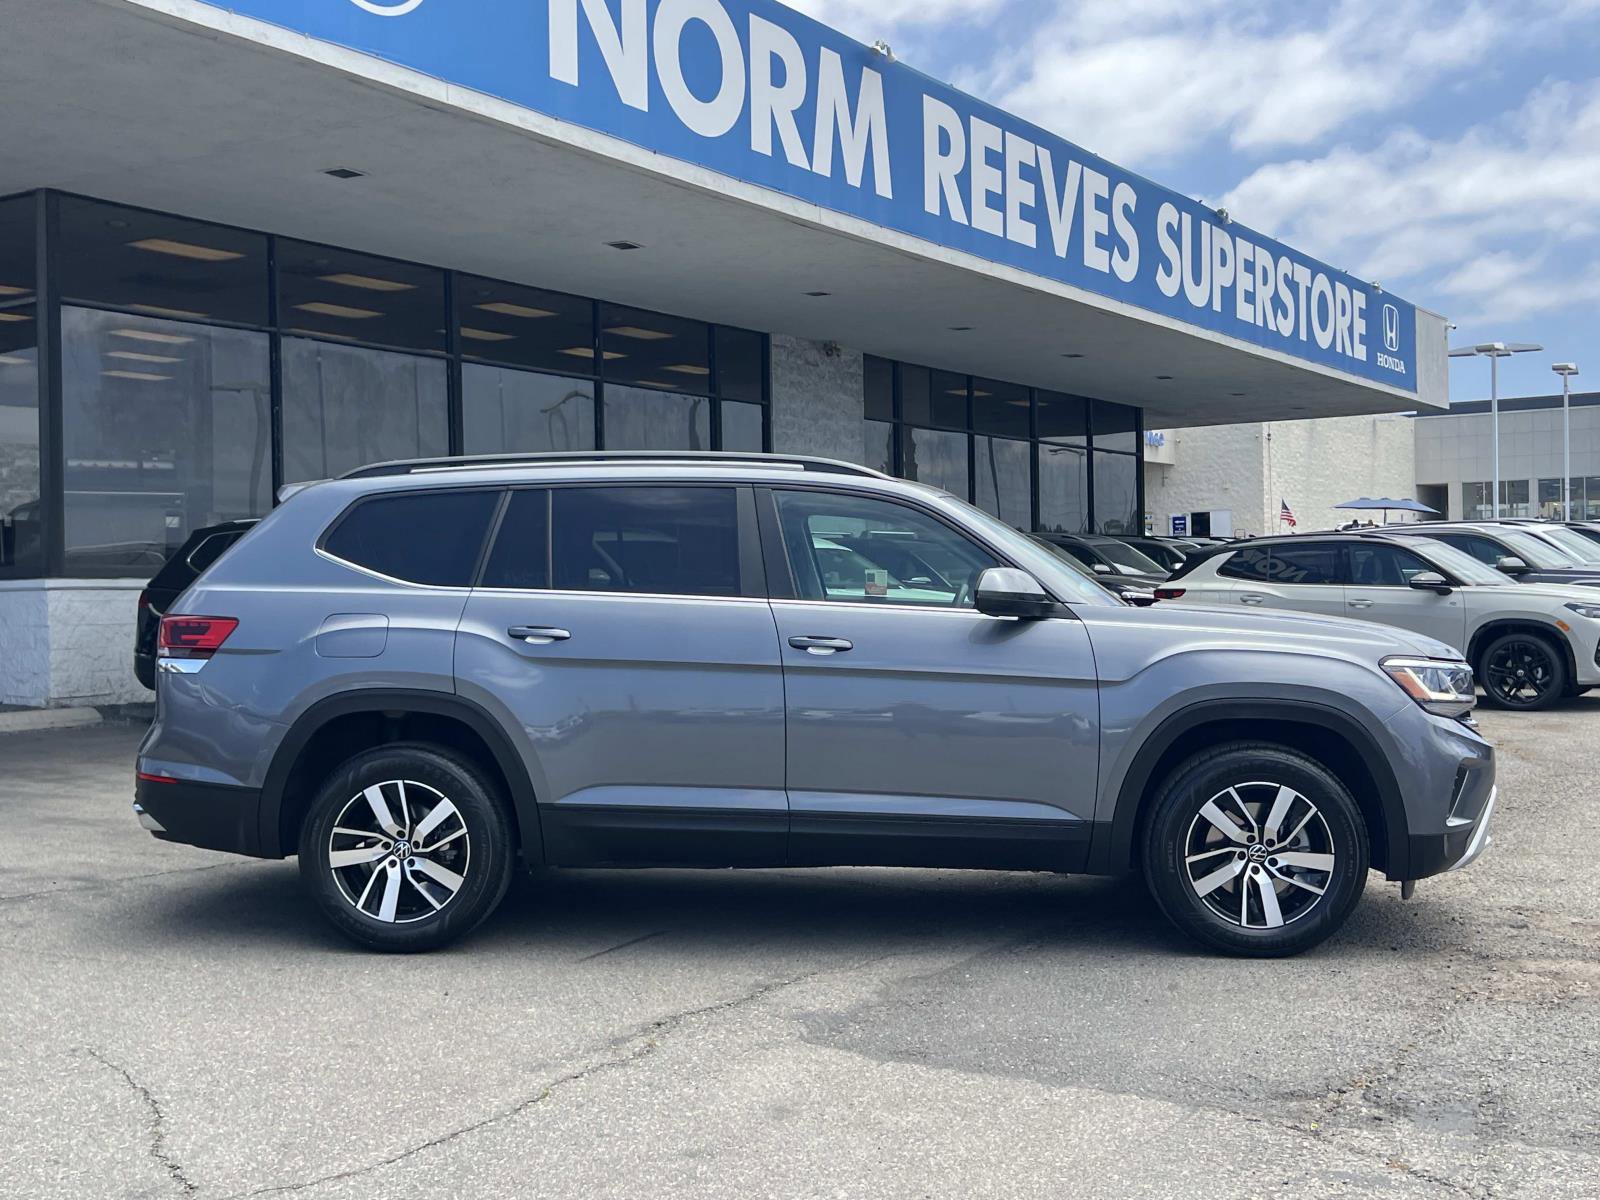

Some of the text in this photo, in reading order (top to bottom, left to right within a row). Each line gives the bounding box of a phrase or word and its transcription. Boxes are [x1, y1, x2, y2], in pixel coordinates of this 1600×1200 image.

[548, 0, 1367, 362] NORM REEVES SUPERSTORE
[1377, 352, 1406, 375] HONDA
